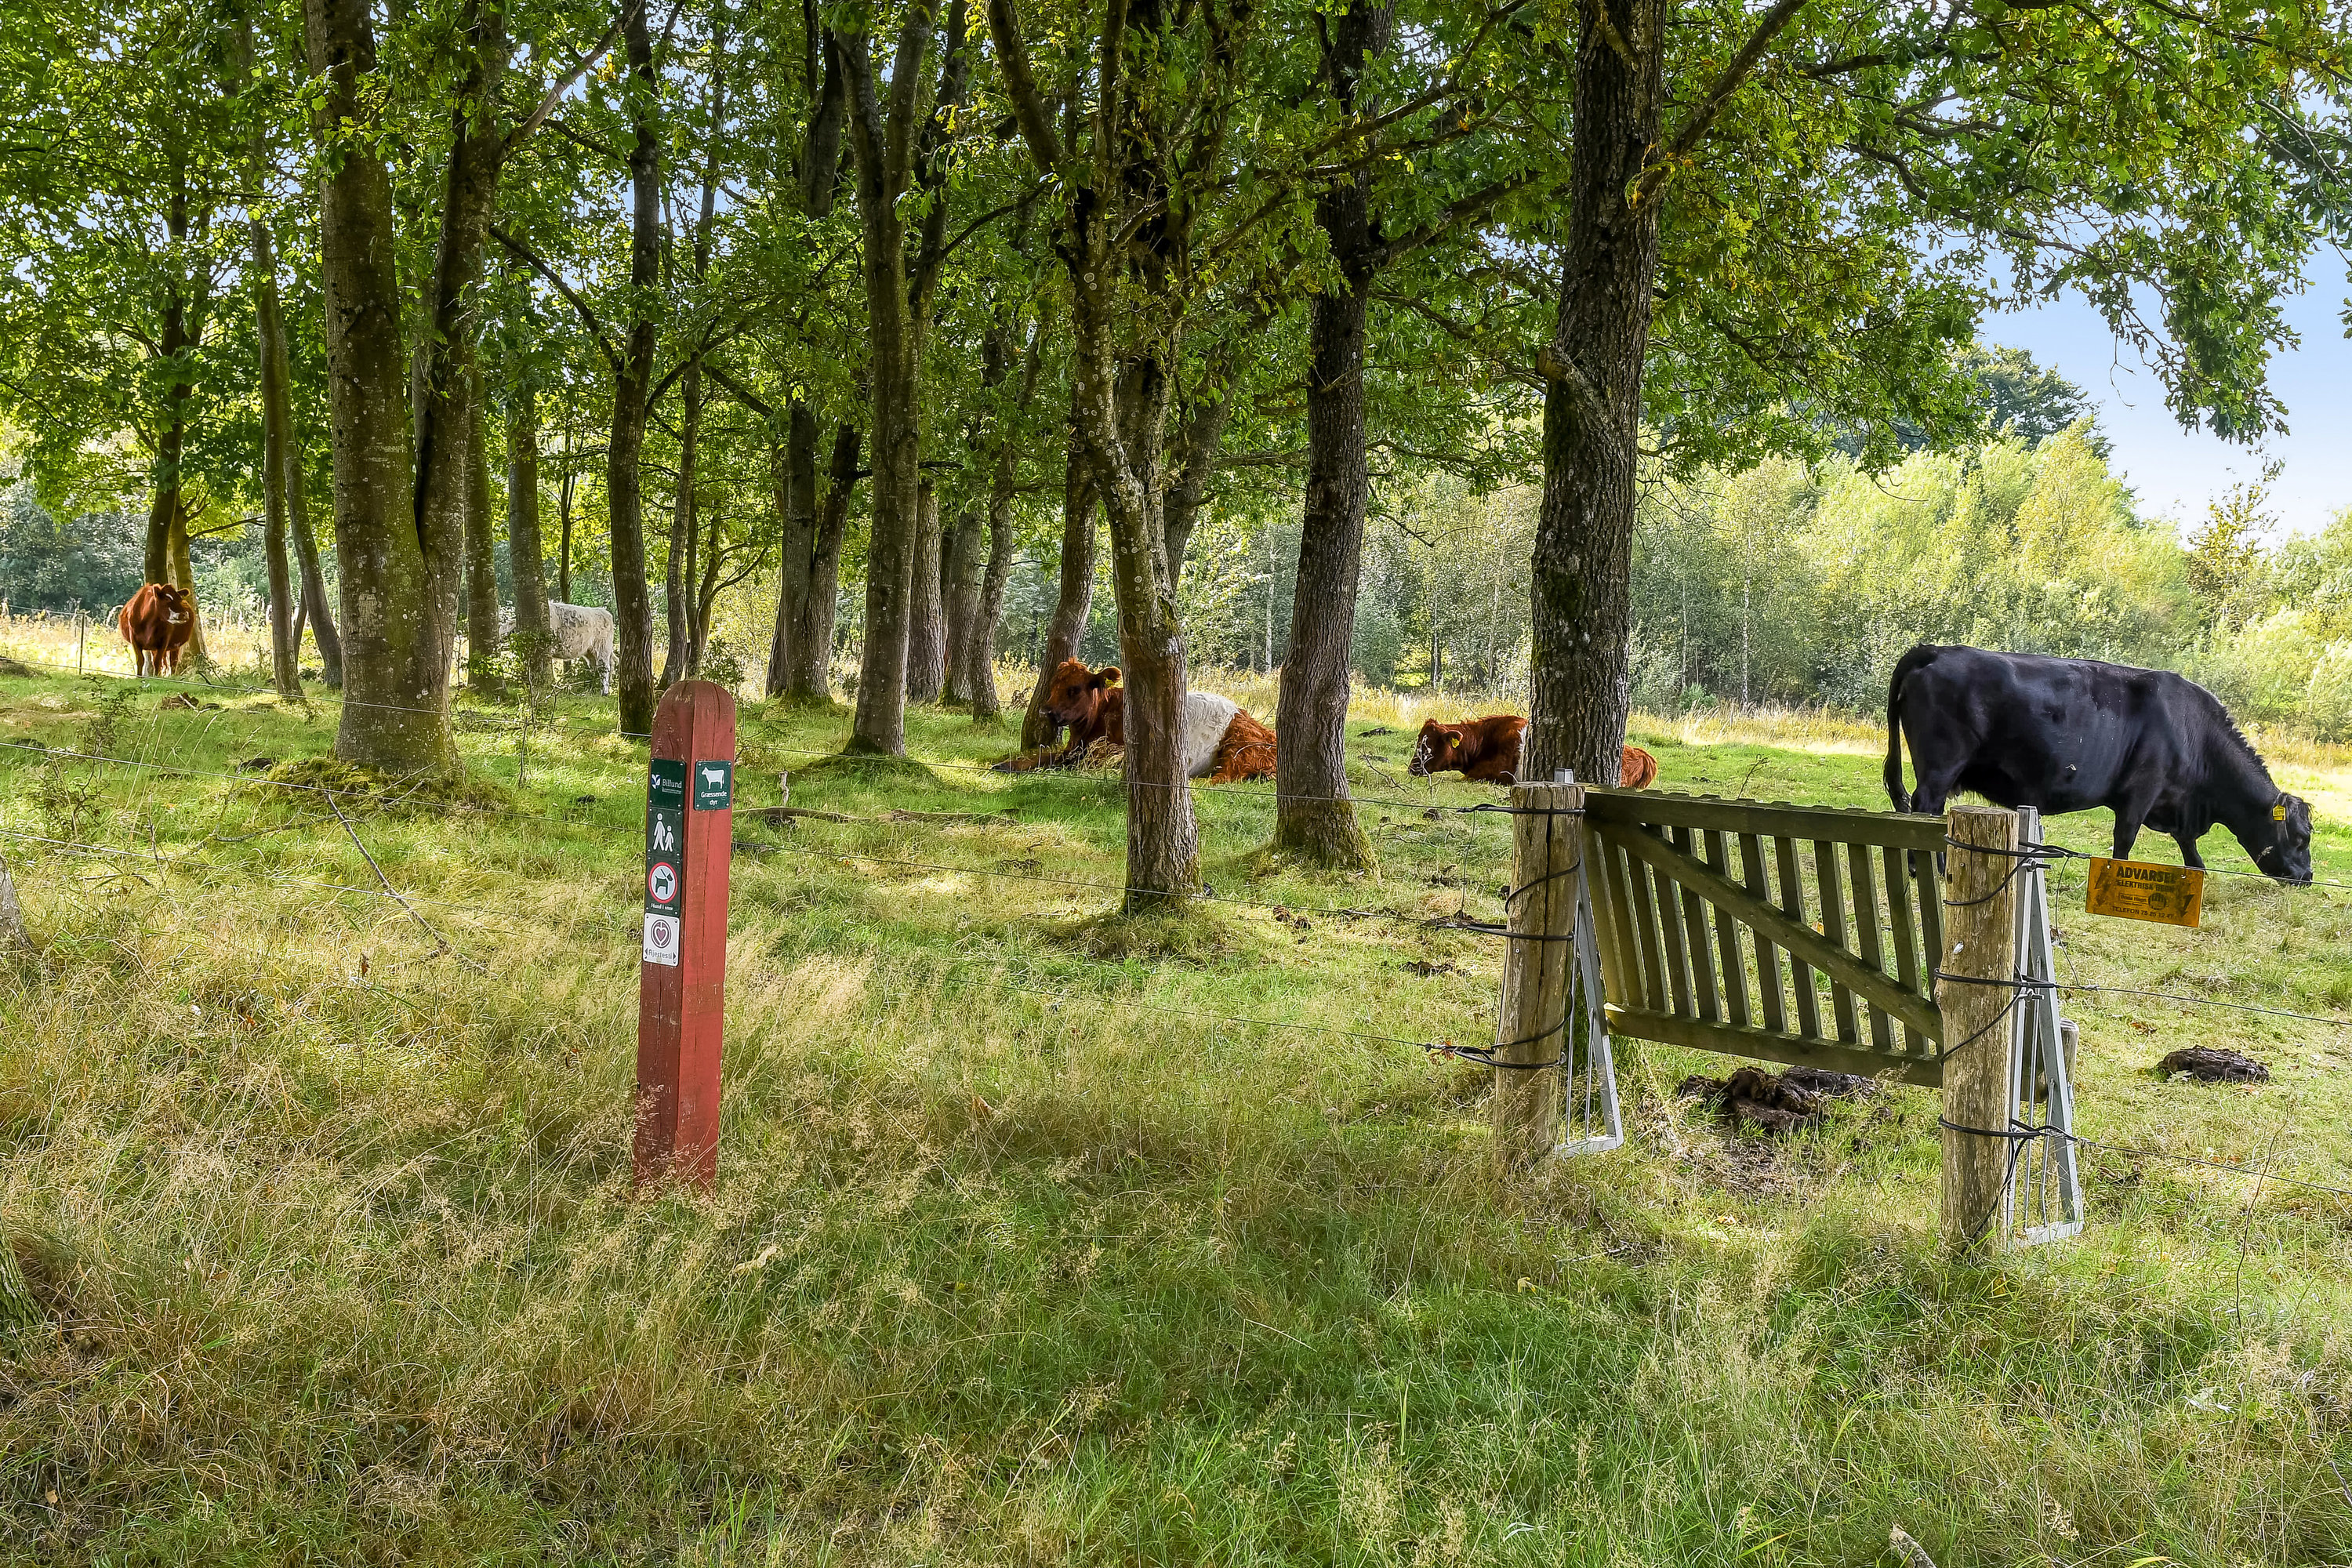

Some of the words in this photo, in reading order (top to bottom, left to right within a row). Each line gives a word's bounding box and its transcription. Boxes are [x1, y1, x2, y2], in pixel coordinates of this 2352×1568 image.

[662, 779, 682, 789] Billund
[2116, 866, 2176, 884] ADVARSEL
[2118, 880, 2154, 890] ELEKTRISK
[2113, 906, 2140, 915] TELEFON
